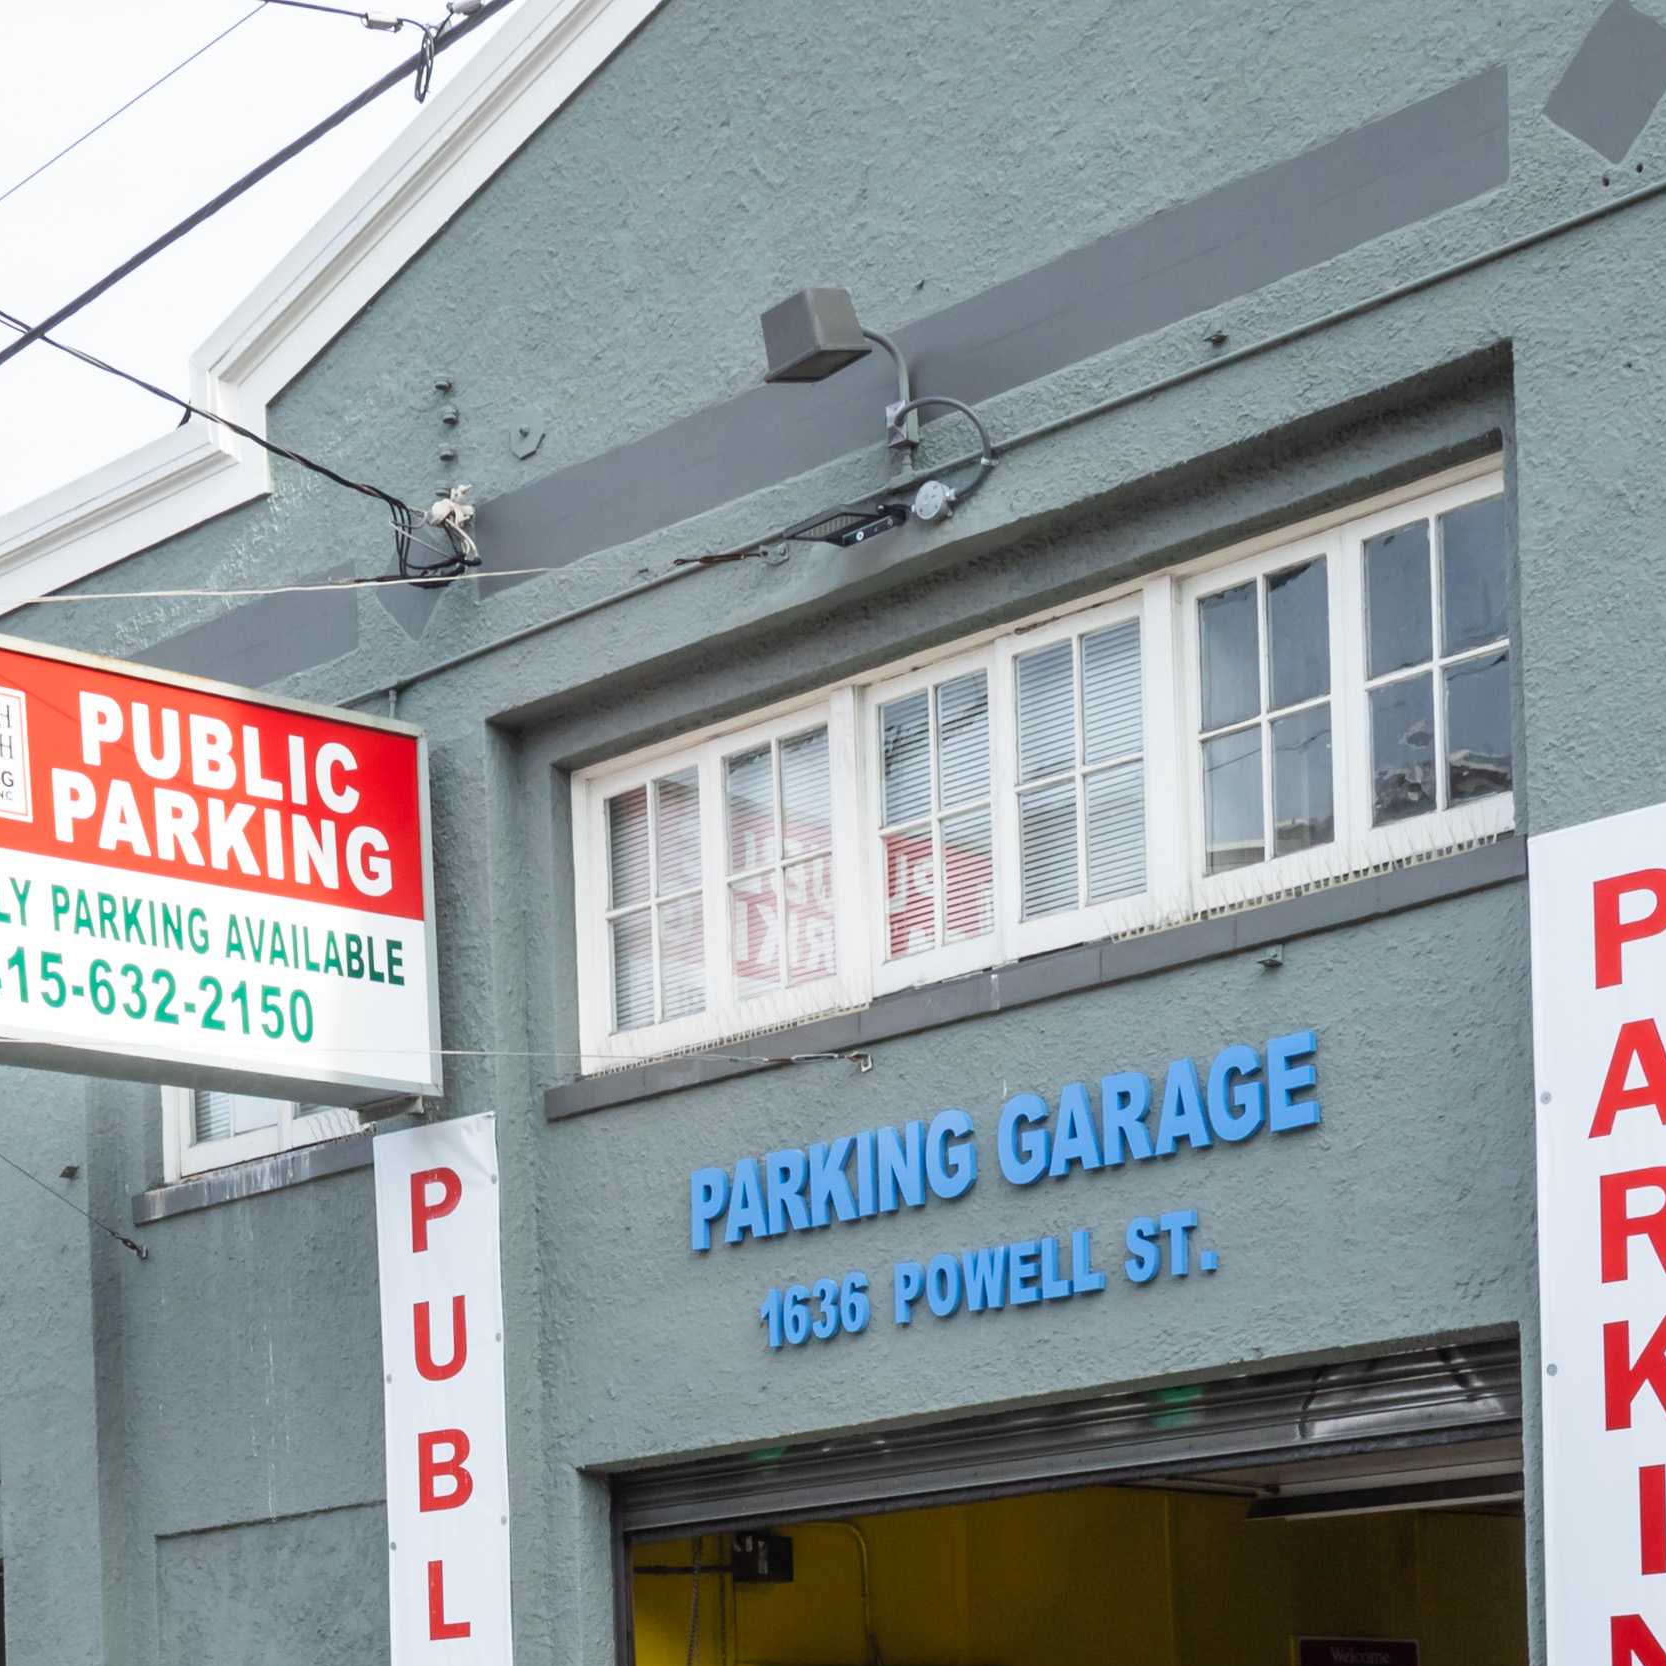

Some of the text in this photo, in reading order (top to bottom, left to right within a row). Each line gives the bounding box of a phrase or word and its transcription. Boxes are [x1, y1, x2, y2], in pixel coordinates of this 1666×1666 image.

[79, 691, 359, 814] PUBLIC
[51, 769, 392, 897] PARKING
[52, 884, 209, 955] PARKING
[225, 914, 404, 986] AVAILABLE
[691, 1030, 1321, 1252] PARKING GARAGE
[760, 1209, 1219, 1348] 1636 POWELL ST.
